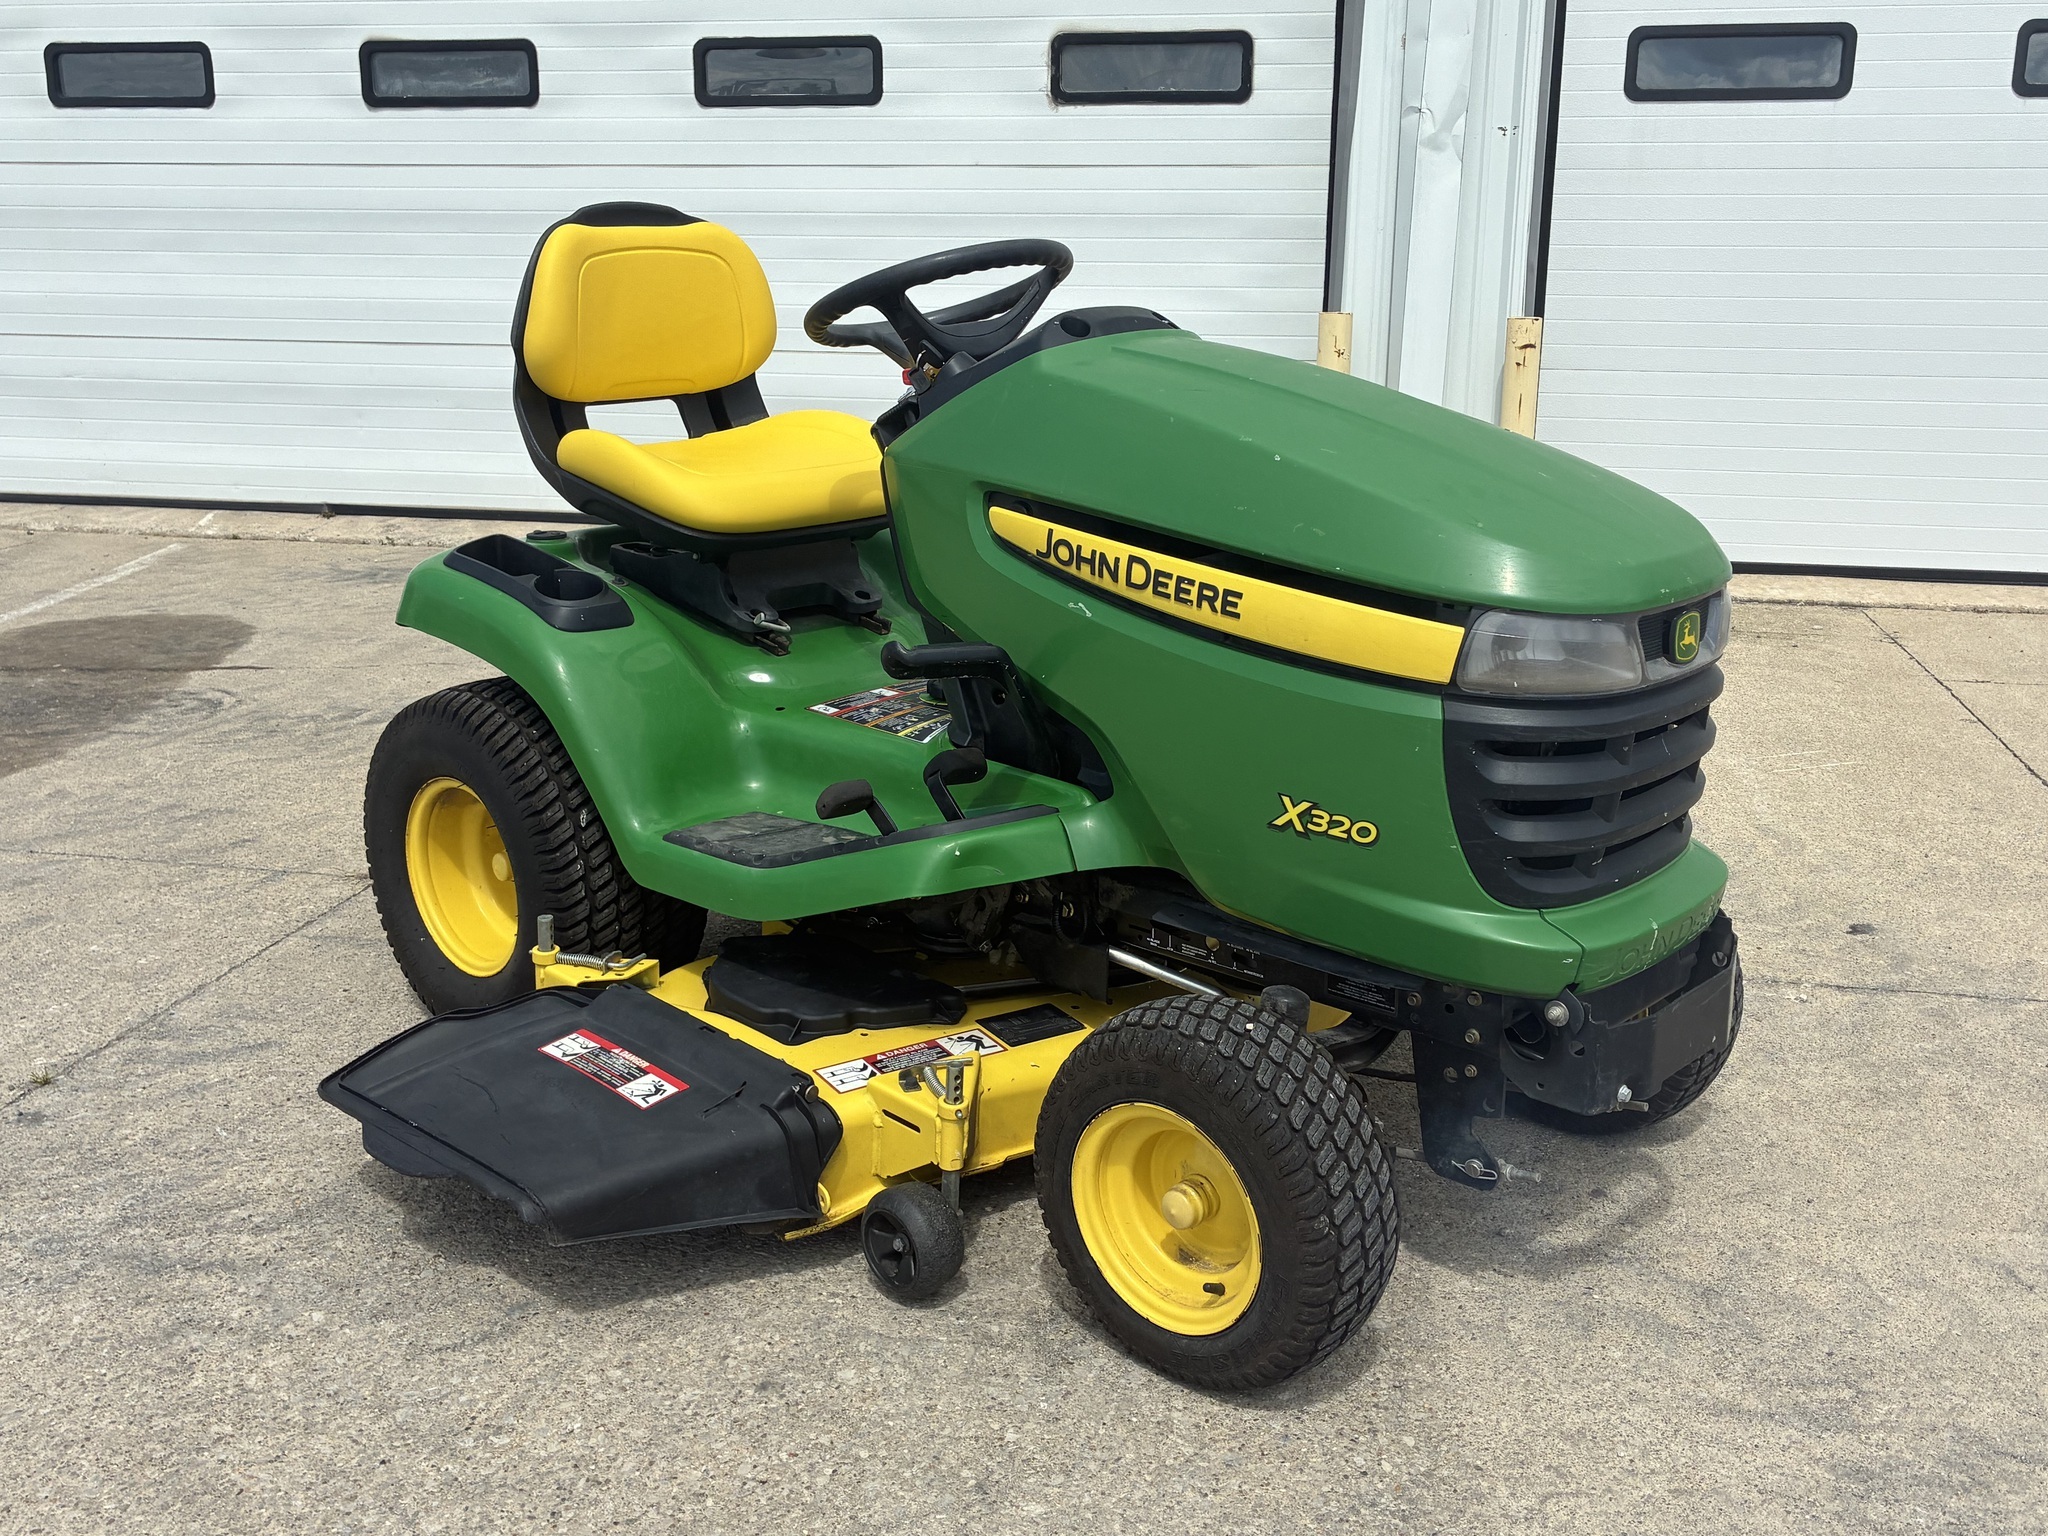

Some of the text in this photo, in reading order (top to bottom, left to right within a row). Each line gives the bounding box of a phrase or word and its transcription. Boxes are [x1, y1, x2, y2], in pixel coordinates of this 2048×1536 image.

[1036, 528, 1244, 620] JOHN DEERE
[1267, 792, 1380, 848] X320
[620, 1049, 651, 1069] DANGER
[885, 1043, 929, 1057] DANGER
